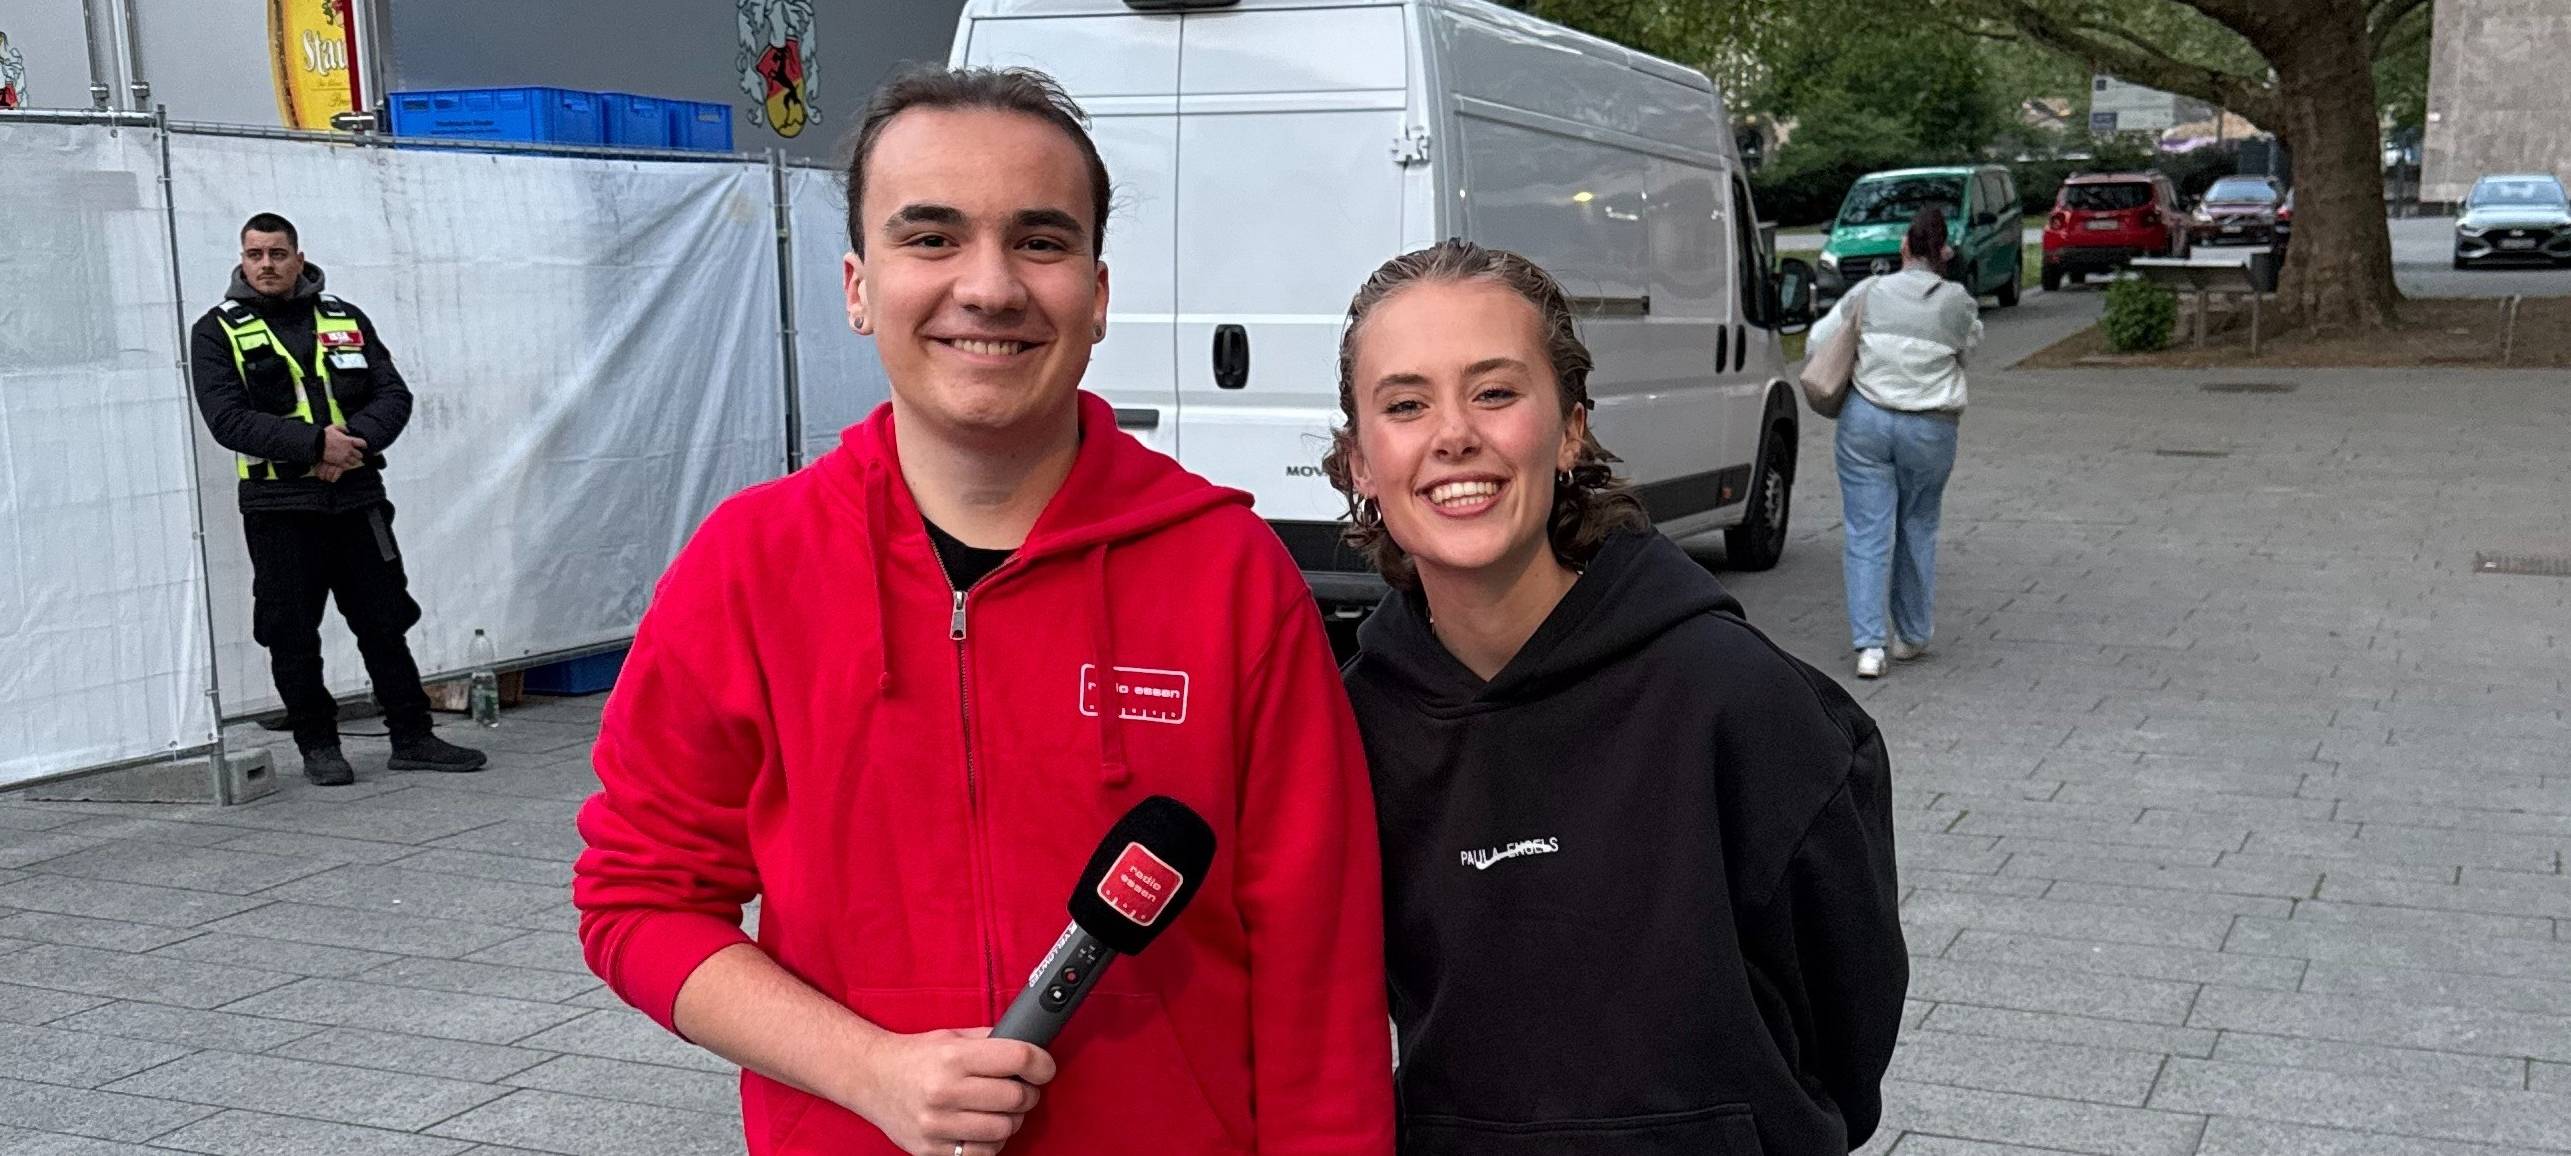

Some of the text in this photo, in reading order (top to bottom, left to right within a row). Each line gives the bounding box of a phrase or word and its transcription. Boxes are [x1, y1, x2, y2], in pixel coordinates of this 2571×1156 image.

[1087, 681, 1180, 699] rio essen
[1460, 846, 1500, 867] PAULA
[1120, 873, 1157, 903] essen
[1129, 865, 1162, 891] radio
